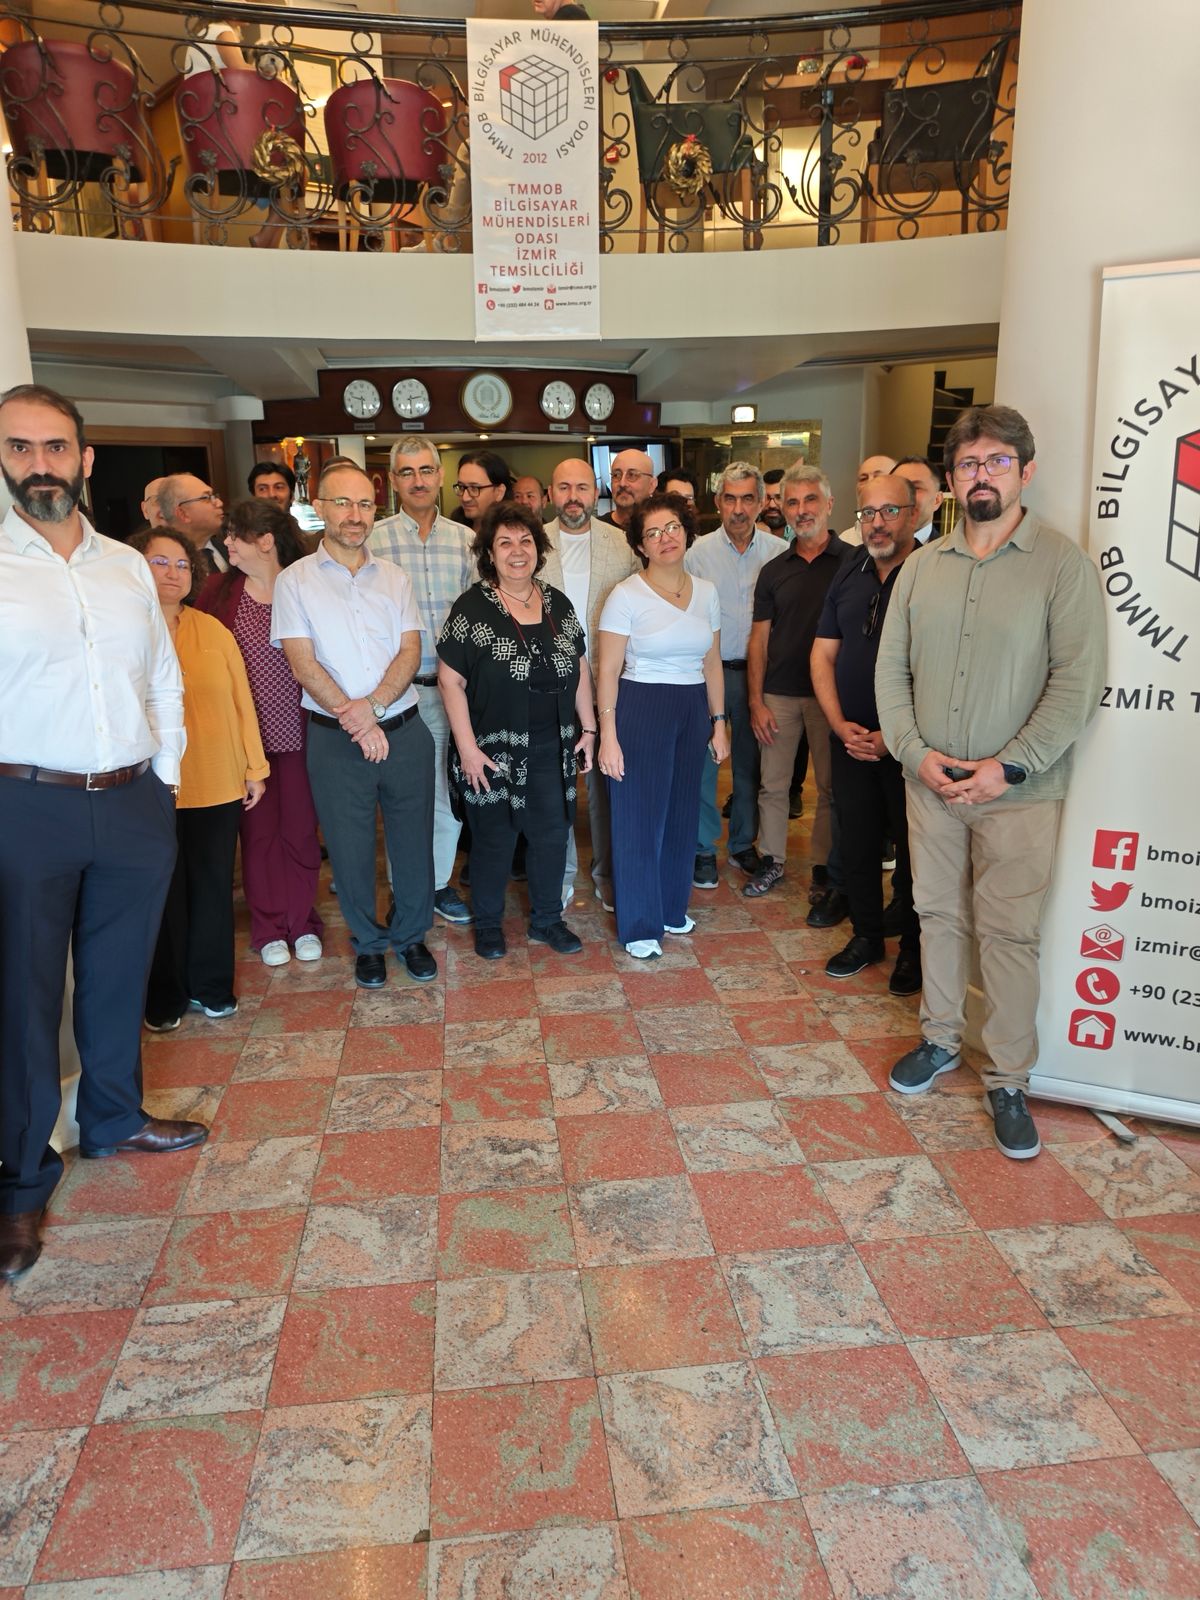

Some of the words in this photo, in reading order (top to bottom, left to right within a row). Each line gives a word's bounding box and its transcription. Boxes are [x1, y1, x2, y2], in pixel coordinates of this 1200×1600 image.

[472, 31, 522, 102] BİLGİSAYAR
[530, 28, 596, 111] MÜHENDİSLERİ
[477, 112, 514, 160] TMMOB
[555, 120, 589, 159] ODASI
[523, 153, 547, 164] 2012
[508, 183, 563, 195] TMMOB
[495, 198, 578, 212] BİLGİSAYAR
[482, 212, 590, 228] MÜHENDİSLERİ
[515, 233, 558, 244] ODASI
[517, 247, 557, 260] İZMİR
[490, 261, 584, 277] TEMSİLCİLİĞİ
[1096, 354, 1200, 519] BİLGİSAY
[1100, 545, 1189, 663] TMMOB
[1100, 684, 1174, 711] ZMİR
[1130, 984, 1166, 1000] +90
